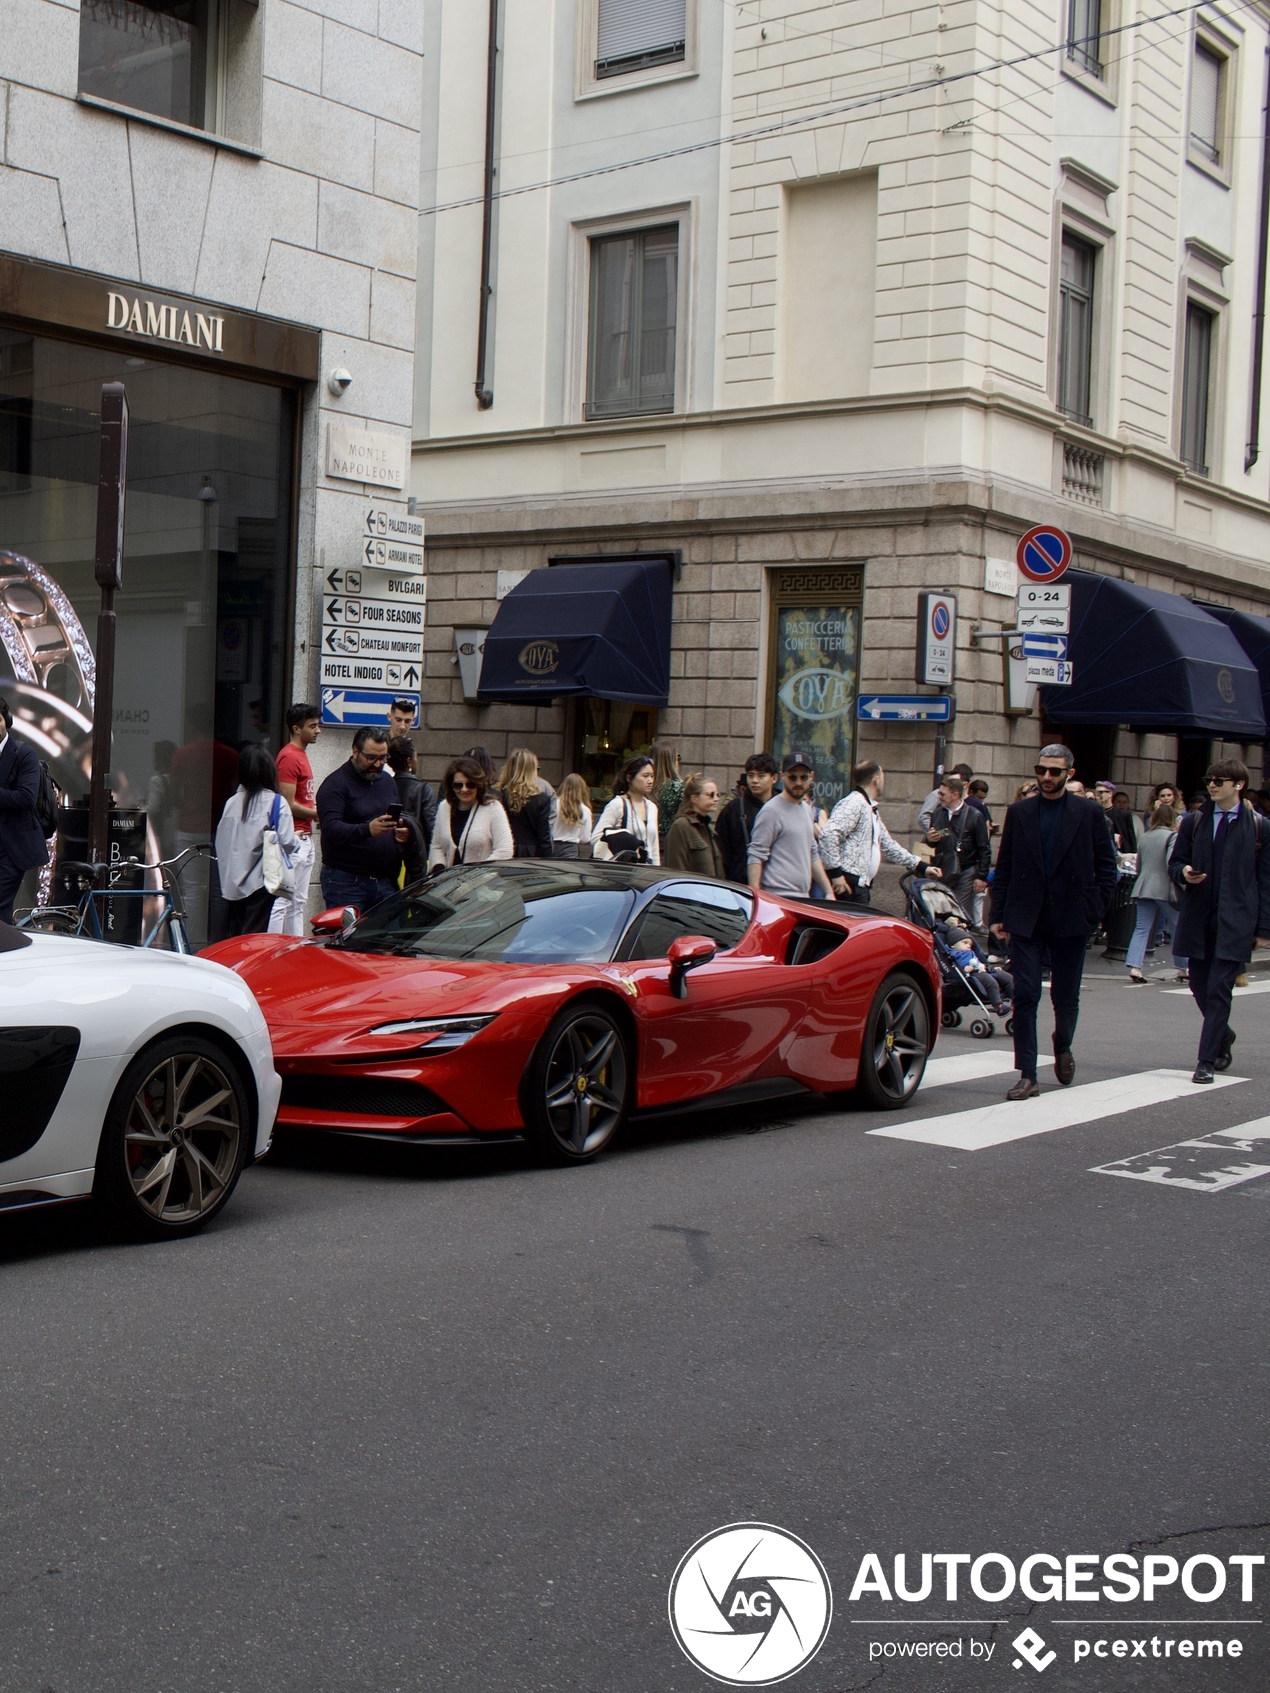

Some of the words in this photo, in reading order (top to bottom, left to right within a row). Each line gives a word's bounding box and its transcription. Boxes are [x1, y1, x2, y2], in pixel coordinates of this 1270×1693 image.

[105, 292, 225, 352] DAMIANI
[348, 444, 387, 462] MONTE
[333, 458, 400, 482] NAPOLEONE
[388, 519, 407, 534] PALAZZO
[408, 522, 423, 537] PARIGI
[388, 549, 407, 563] ARMANI
[408, 552, 423, 566] HOTEL
[388, 580, 424, 595] BVLGARI
[363, 606, 384, 621] FOUR
[386, 608, 422, 625] SEASONS
[785, 621, 851, 635] PASTICCERIA
[360, 638, 390, 650] CHATEAU
[391, 640, 421, 653] MONFORT
[784, 636, 851, 650] CONFETTERIA
[324, 663, 352, 678] HOTEL
[353, 665, 383, 680] INDIGO
[112, 819, 135, 828] DAMIANI
